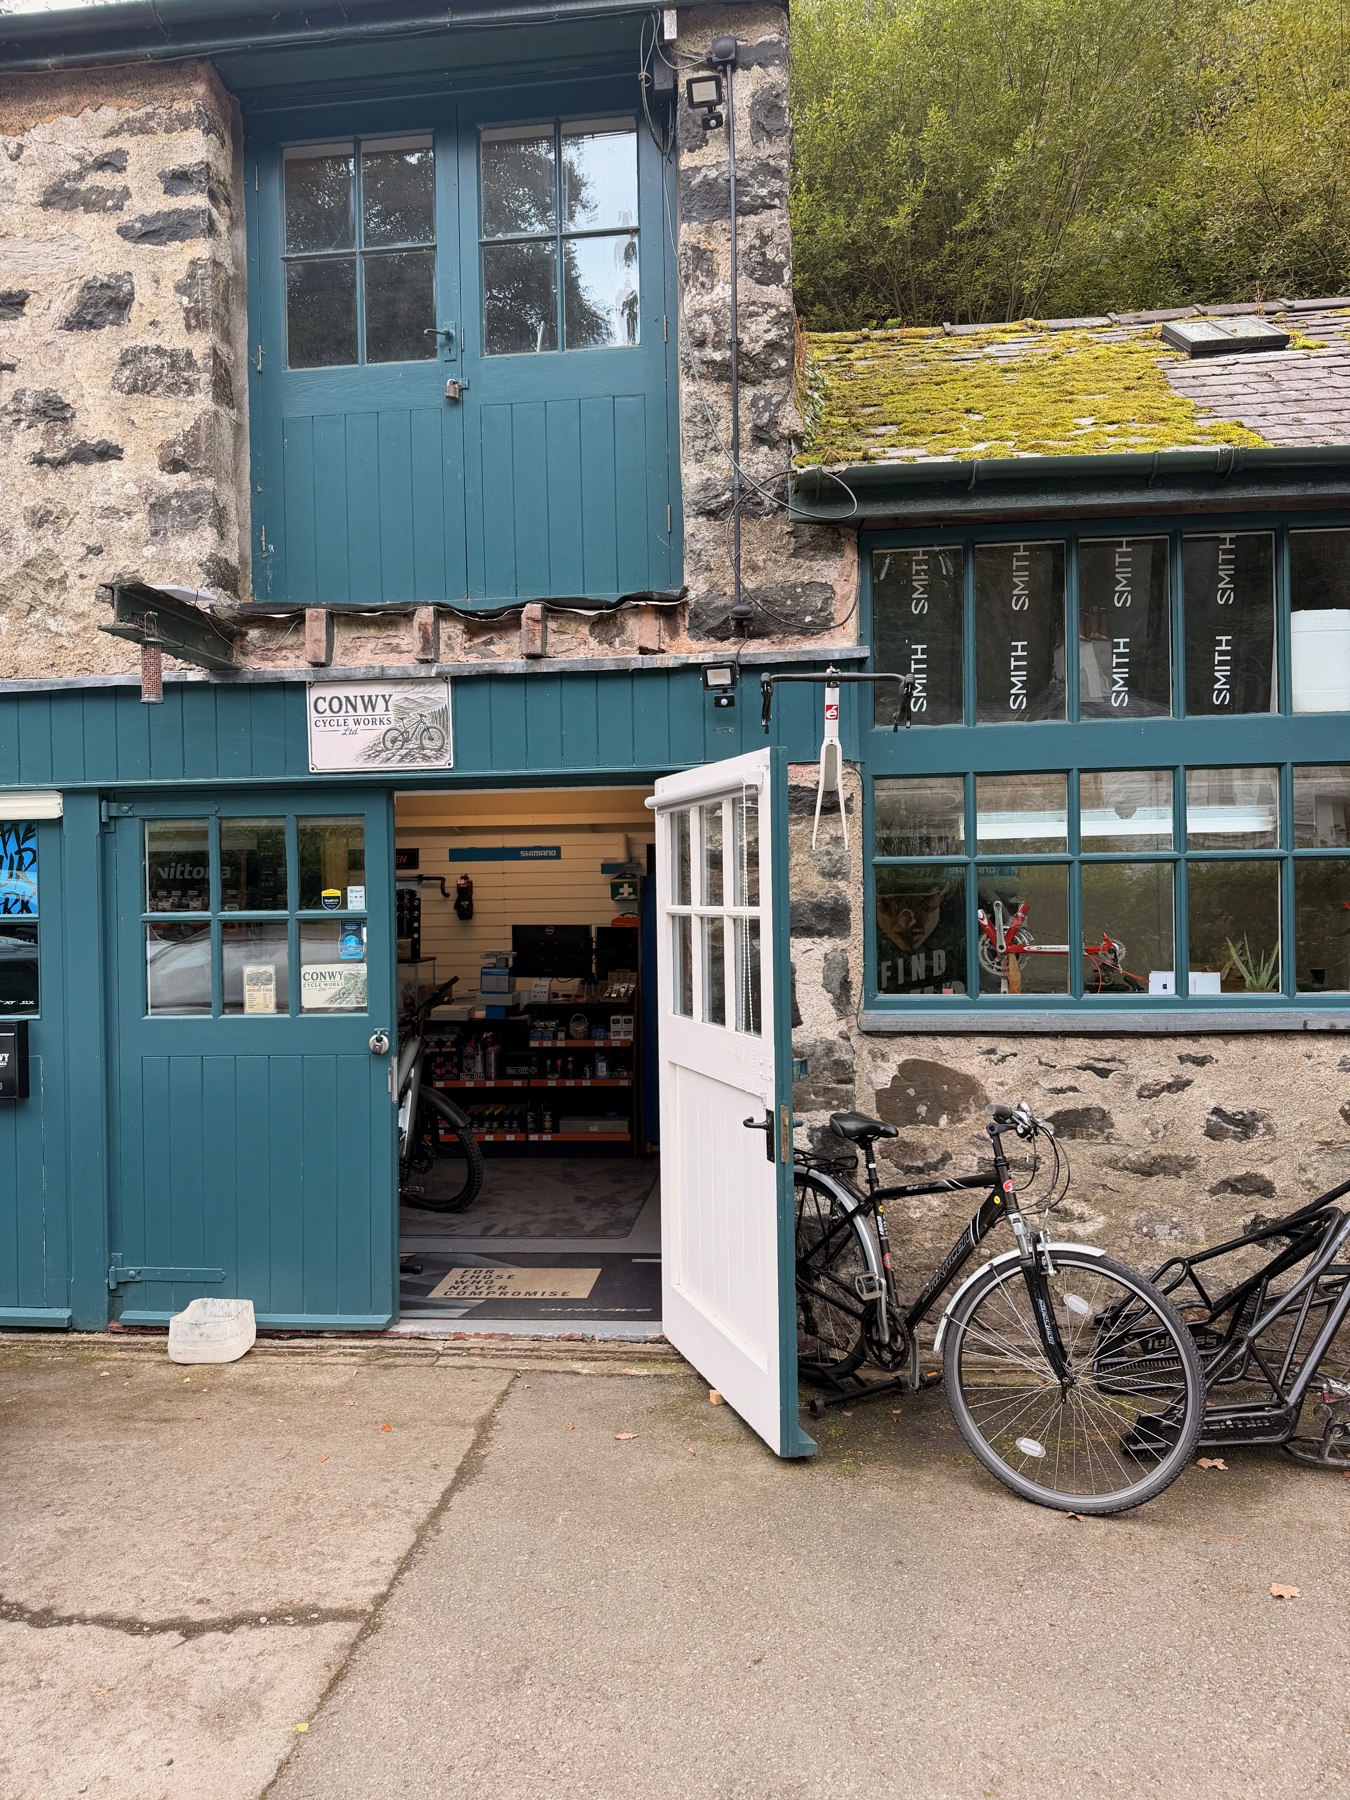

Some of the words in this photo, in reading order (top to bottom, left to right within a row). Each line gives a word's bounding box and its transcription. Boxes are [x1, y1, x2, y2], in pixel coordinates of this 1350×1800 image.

[911, 549, 928, 614] SMITH
[1012, 544, 1029, 611] SMITH
[1114, 539, 1133, 607] SMITH
[1217, 535, 1236, 604] SMITH
[910, 644, 927, 712] SMITH
[1010, 641, 1027, 710] SMITH
[1111, 638, 1130, 707] SMITH
[1213, 635, 1232, 705] SMITH
[313, 694, 393, 715] CONWY
[314, 718, 350, 728] CYCLE
[353, 716, 392, 726] WORKS
[341, 727, 359, 736] Ltd
[303, 971, 344, 981] CONWY
[881, 949, 946, 988] FIND
